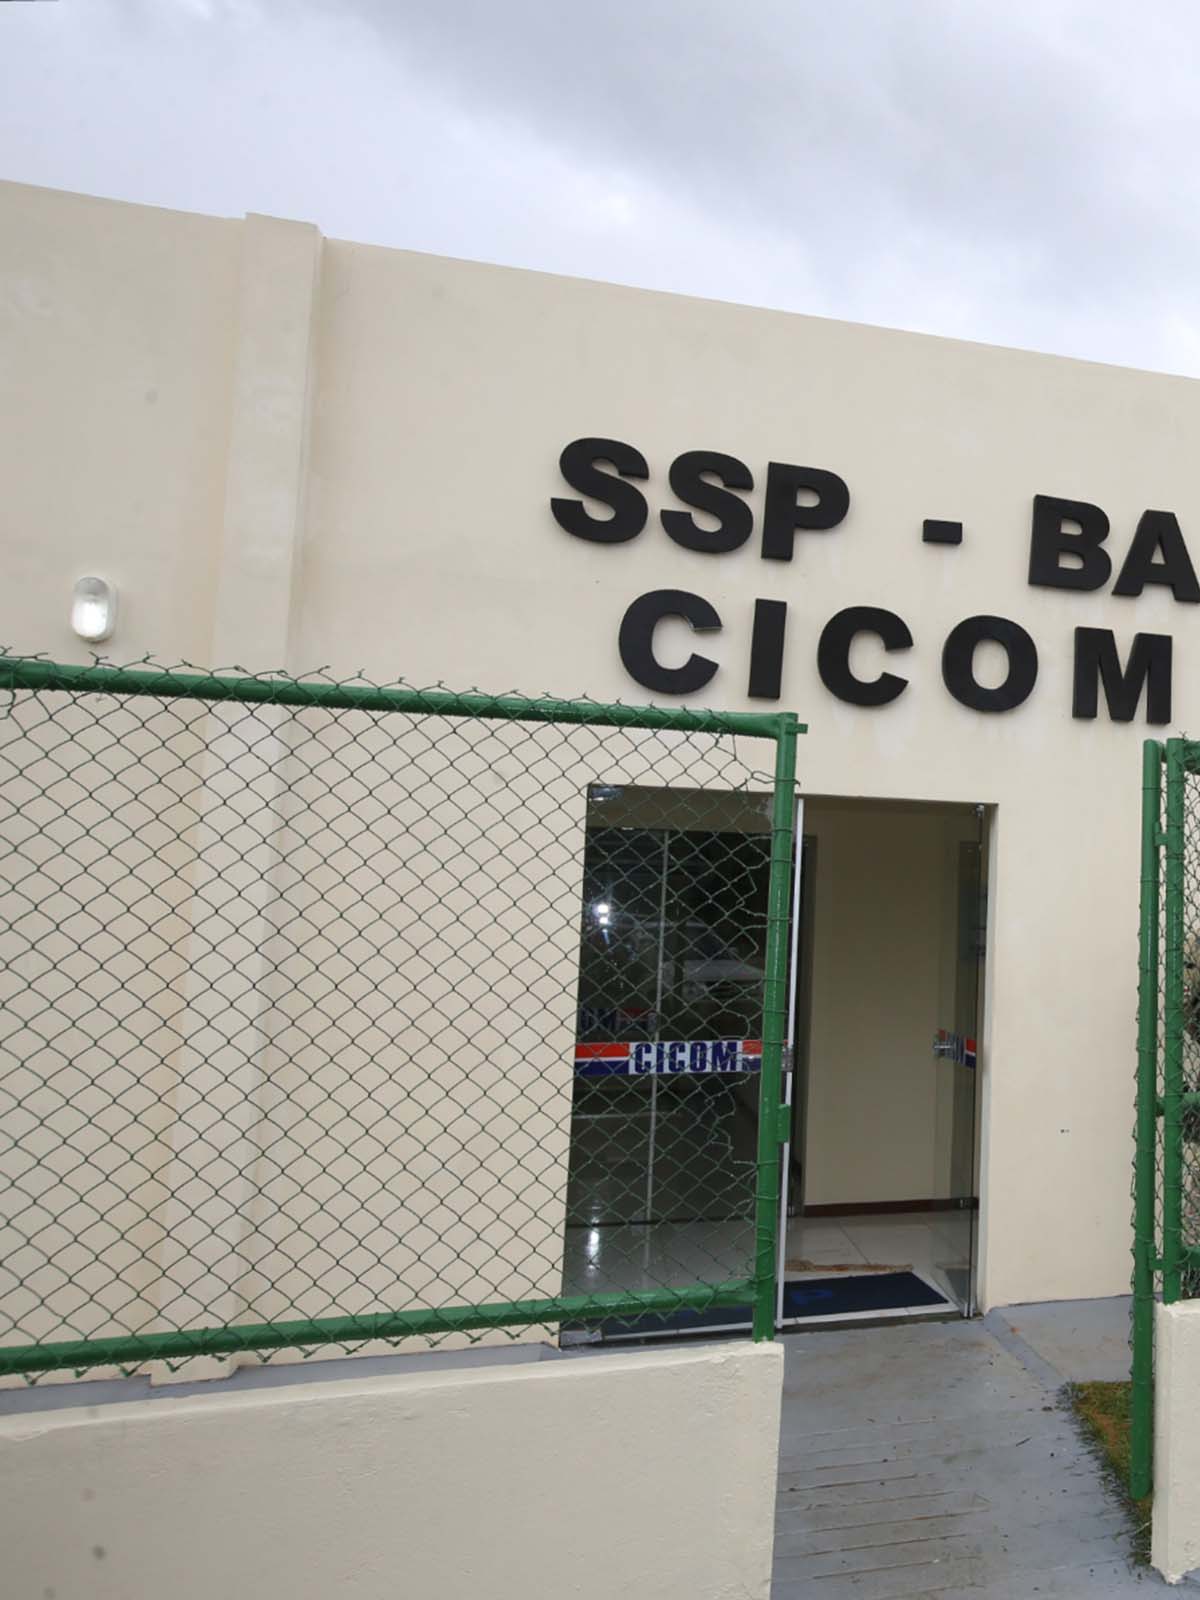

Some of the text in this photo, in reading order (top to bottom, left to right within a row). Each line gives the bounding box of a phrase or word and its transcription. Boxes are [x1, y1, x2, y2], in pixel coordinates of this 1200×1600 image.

[550, 437, 850, 562] SSP
[922, 519, 963, 546] -
[618, 588, 1173, 726] CICOM
[633, 1041, 739, 1074] CICOM
